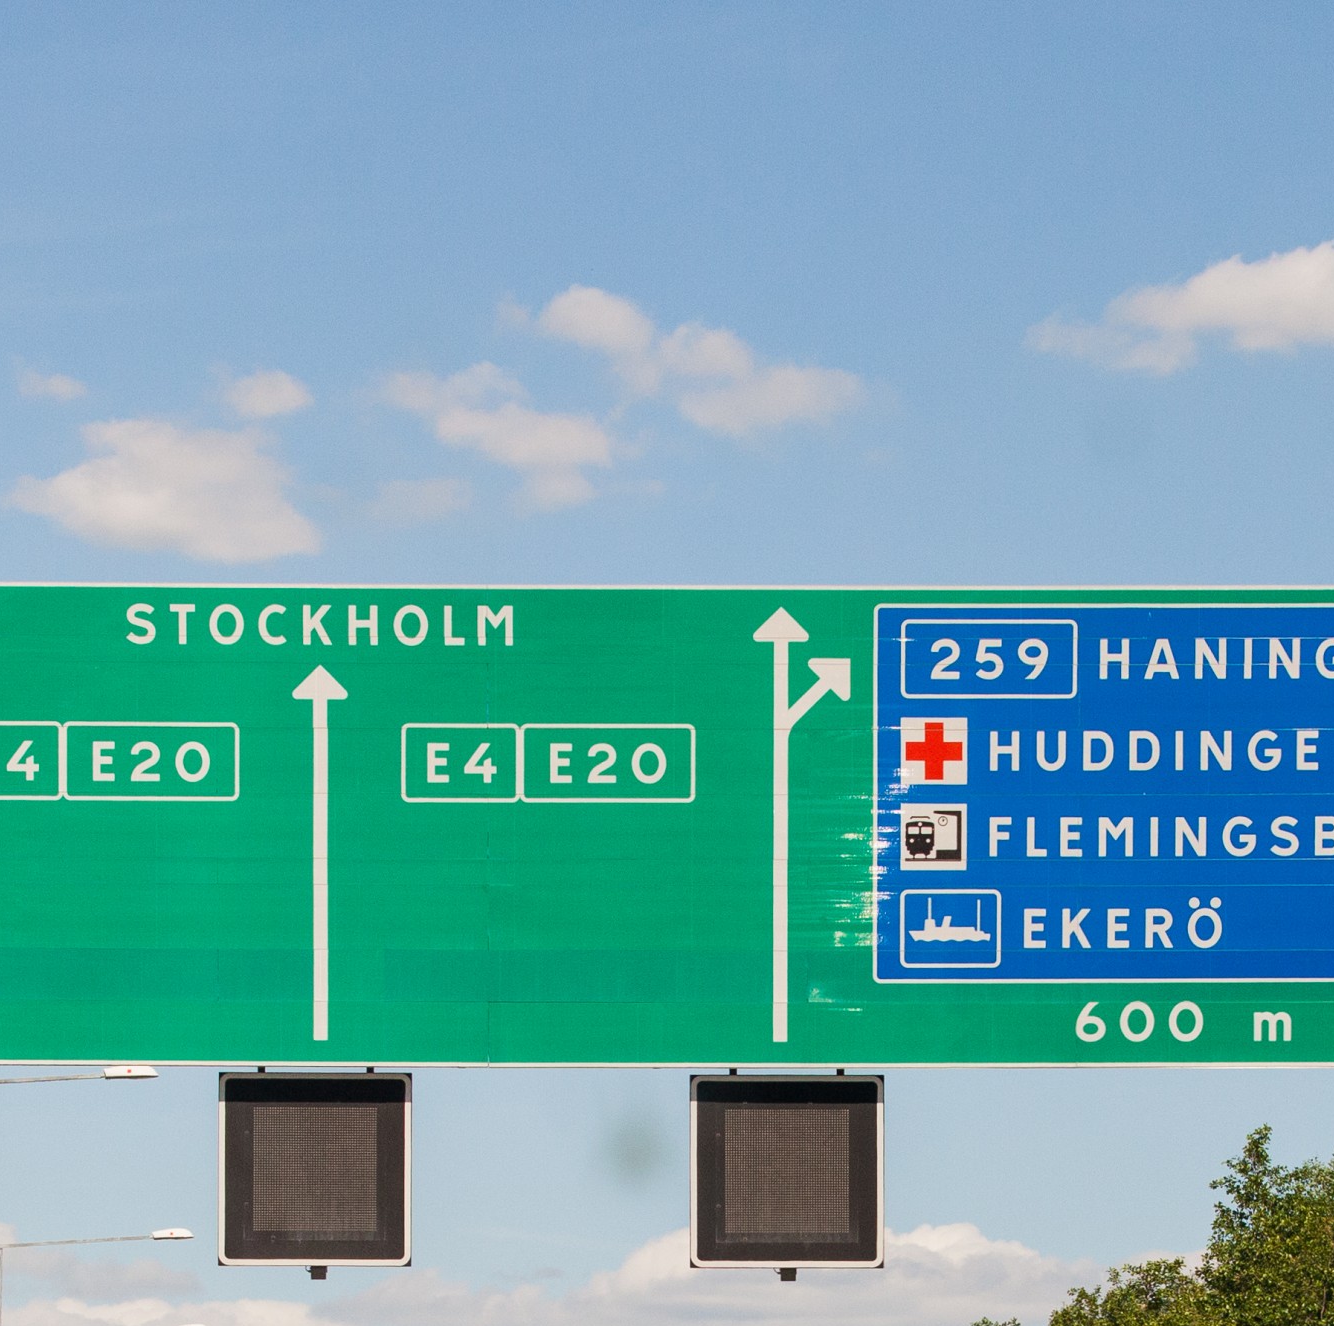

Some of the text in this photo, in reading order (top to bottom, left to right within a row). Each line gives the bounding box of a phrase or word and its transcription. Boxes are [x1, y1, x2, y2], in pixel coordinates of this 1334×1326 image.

[126, 603, 514, 647] STOCKHOLM
[930, 638, 1049, 680] 259
[92, 740, 211, 783] E20
[426, 742, 667, 784] E4 E20
[989, 728, 1319, 772] HUDDINGE
[1023, 896, 1223, 949] EKERÖ
[1075, 1000, 1292, 1043] 600 m
